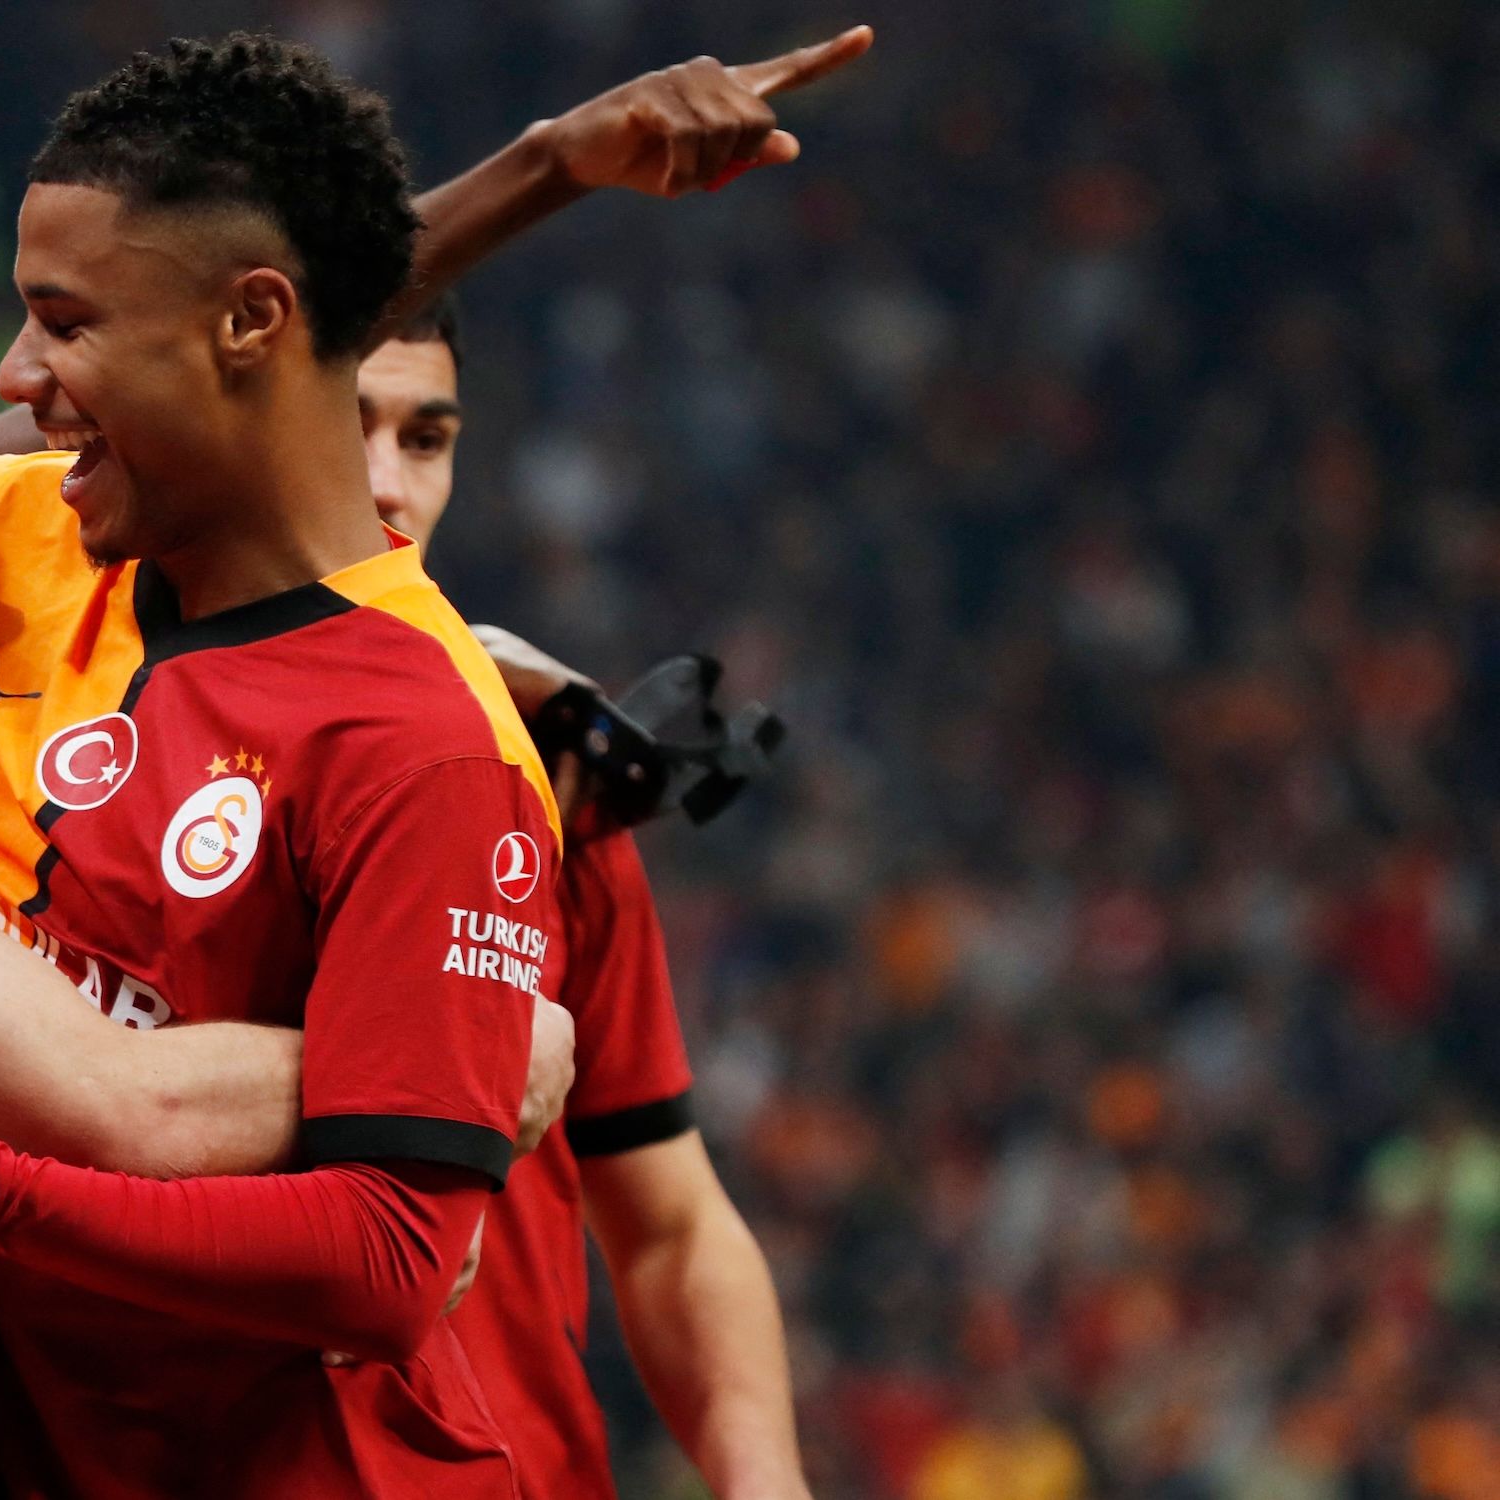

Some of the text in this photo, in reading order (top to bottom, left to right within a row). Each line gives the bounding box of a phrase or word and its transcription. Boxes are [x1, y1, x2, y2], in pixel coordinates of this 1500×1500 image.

[199, 836, 220, 851] 1905
[447, 907, 548, 964] TURKISH
[442, 943, 542, 997] AIRLINE
